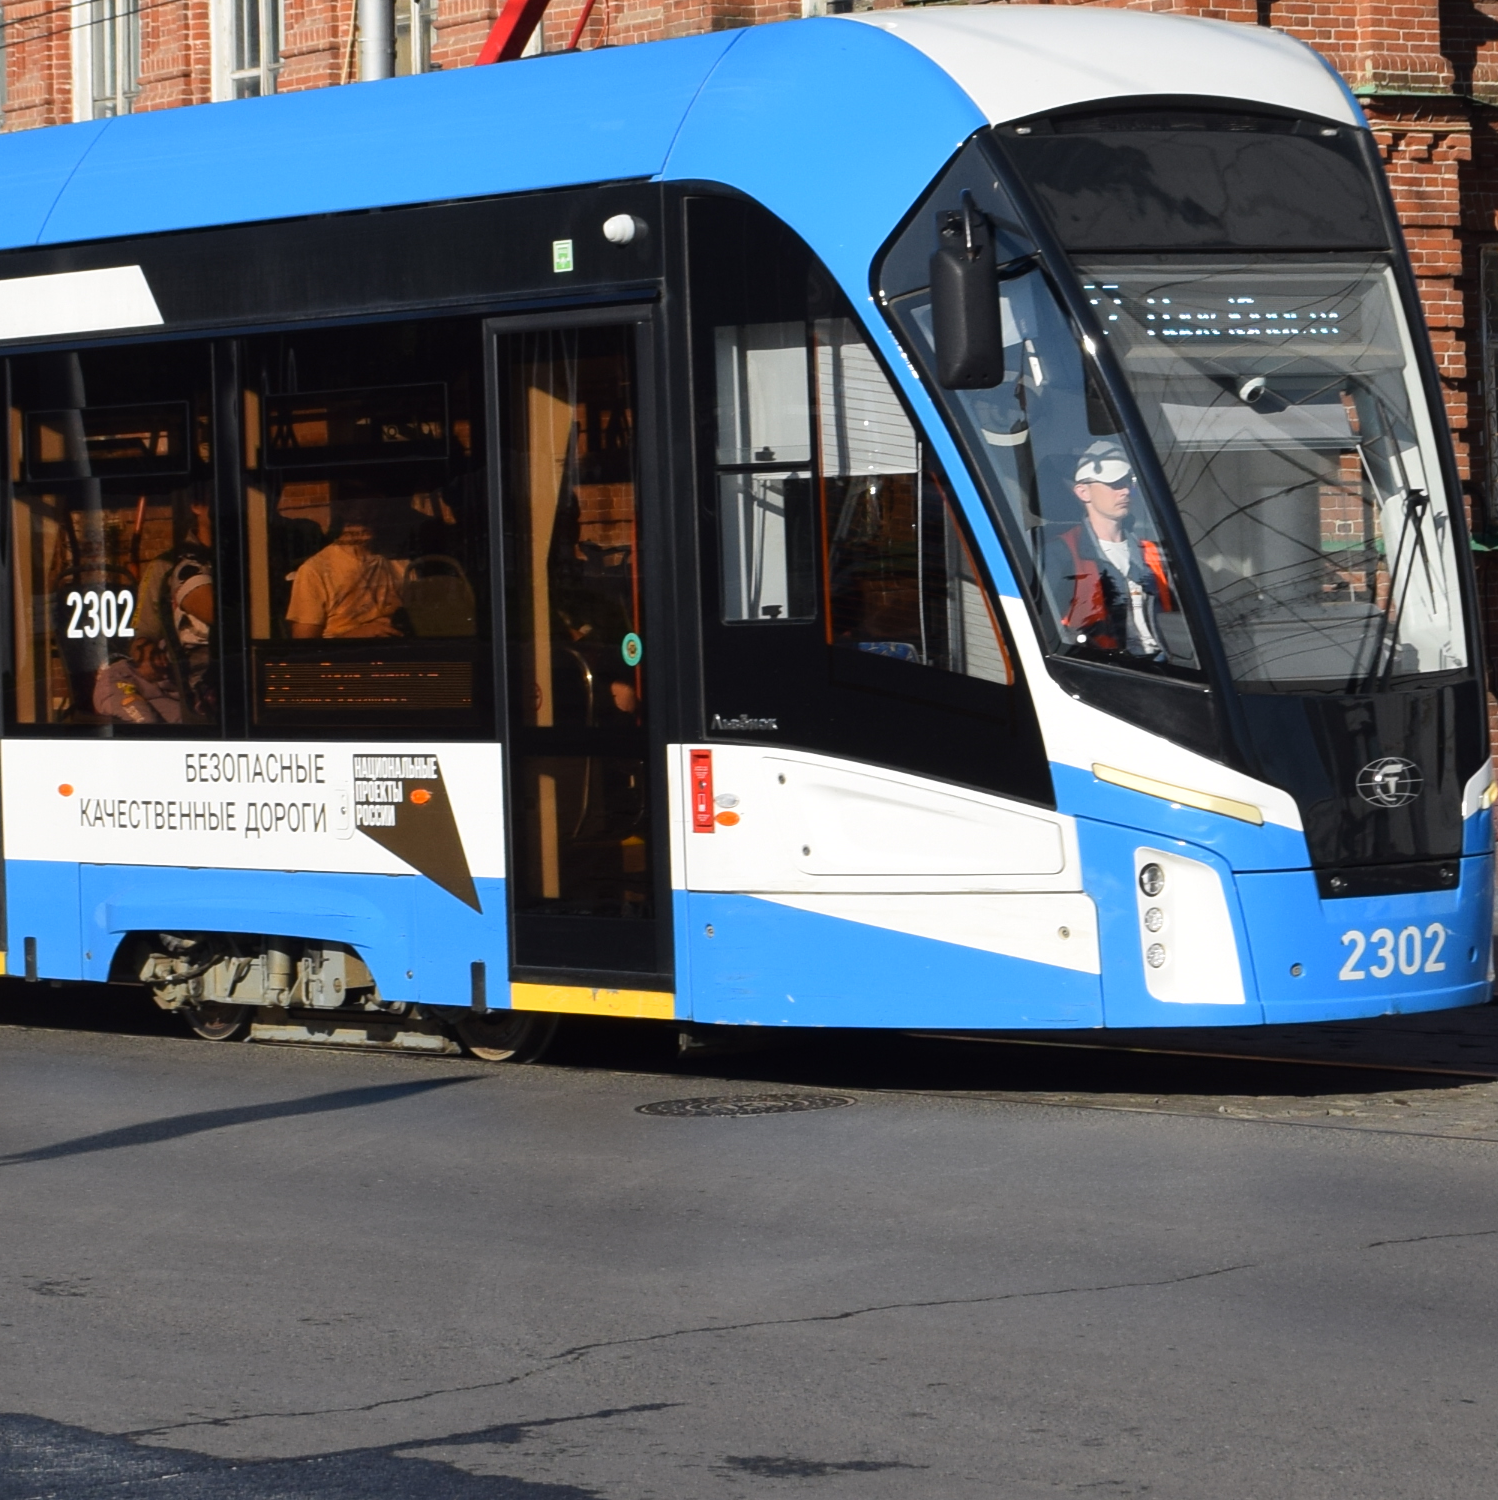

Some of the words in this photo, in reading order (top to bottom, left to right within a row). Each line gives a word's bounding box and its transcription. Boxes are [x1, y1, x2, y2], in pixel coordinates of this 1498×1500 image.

[66, 589, 135, 639] 2302
[184, 752, 326, 784] БЕЗОПАСНЫЕ
[353, 756, 438, 781] НАЦИОНАЛЬНЫЕ
[355, 780, 403, 803] ПРОЕКТЫ
[79, 798, 237, 832] КАЧЕСТВЕННЫЕ
[244, 801, 328, 839] ДОРОГИ
[355, 804, 396, 827] РОССИИ
[1339, 922, 1446, 981] 2302
